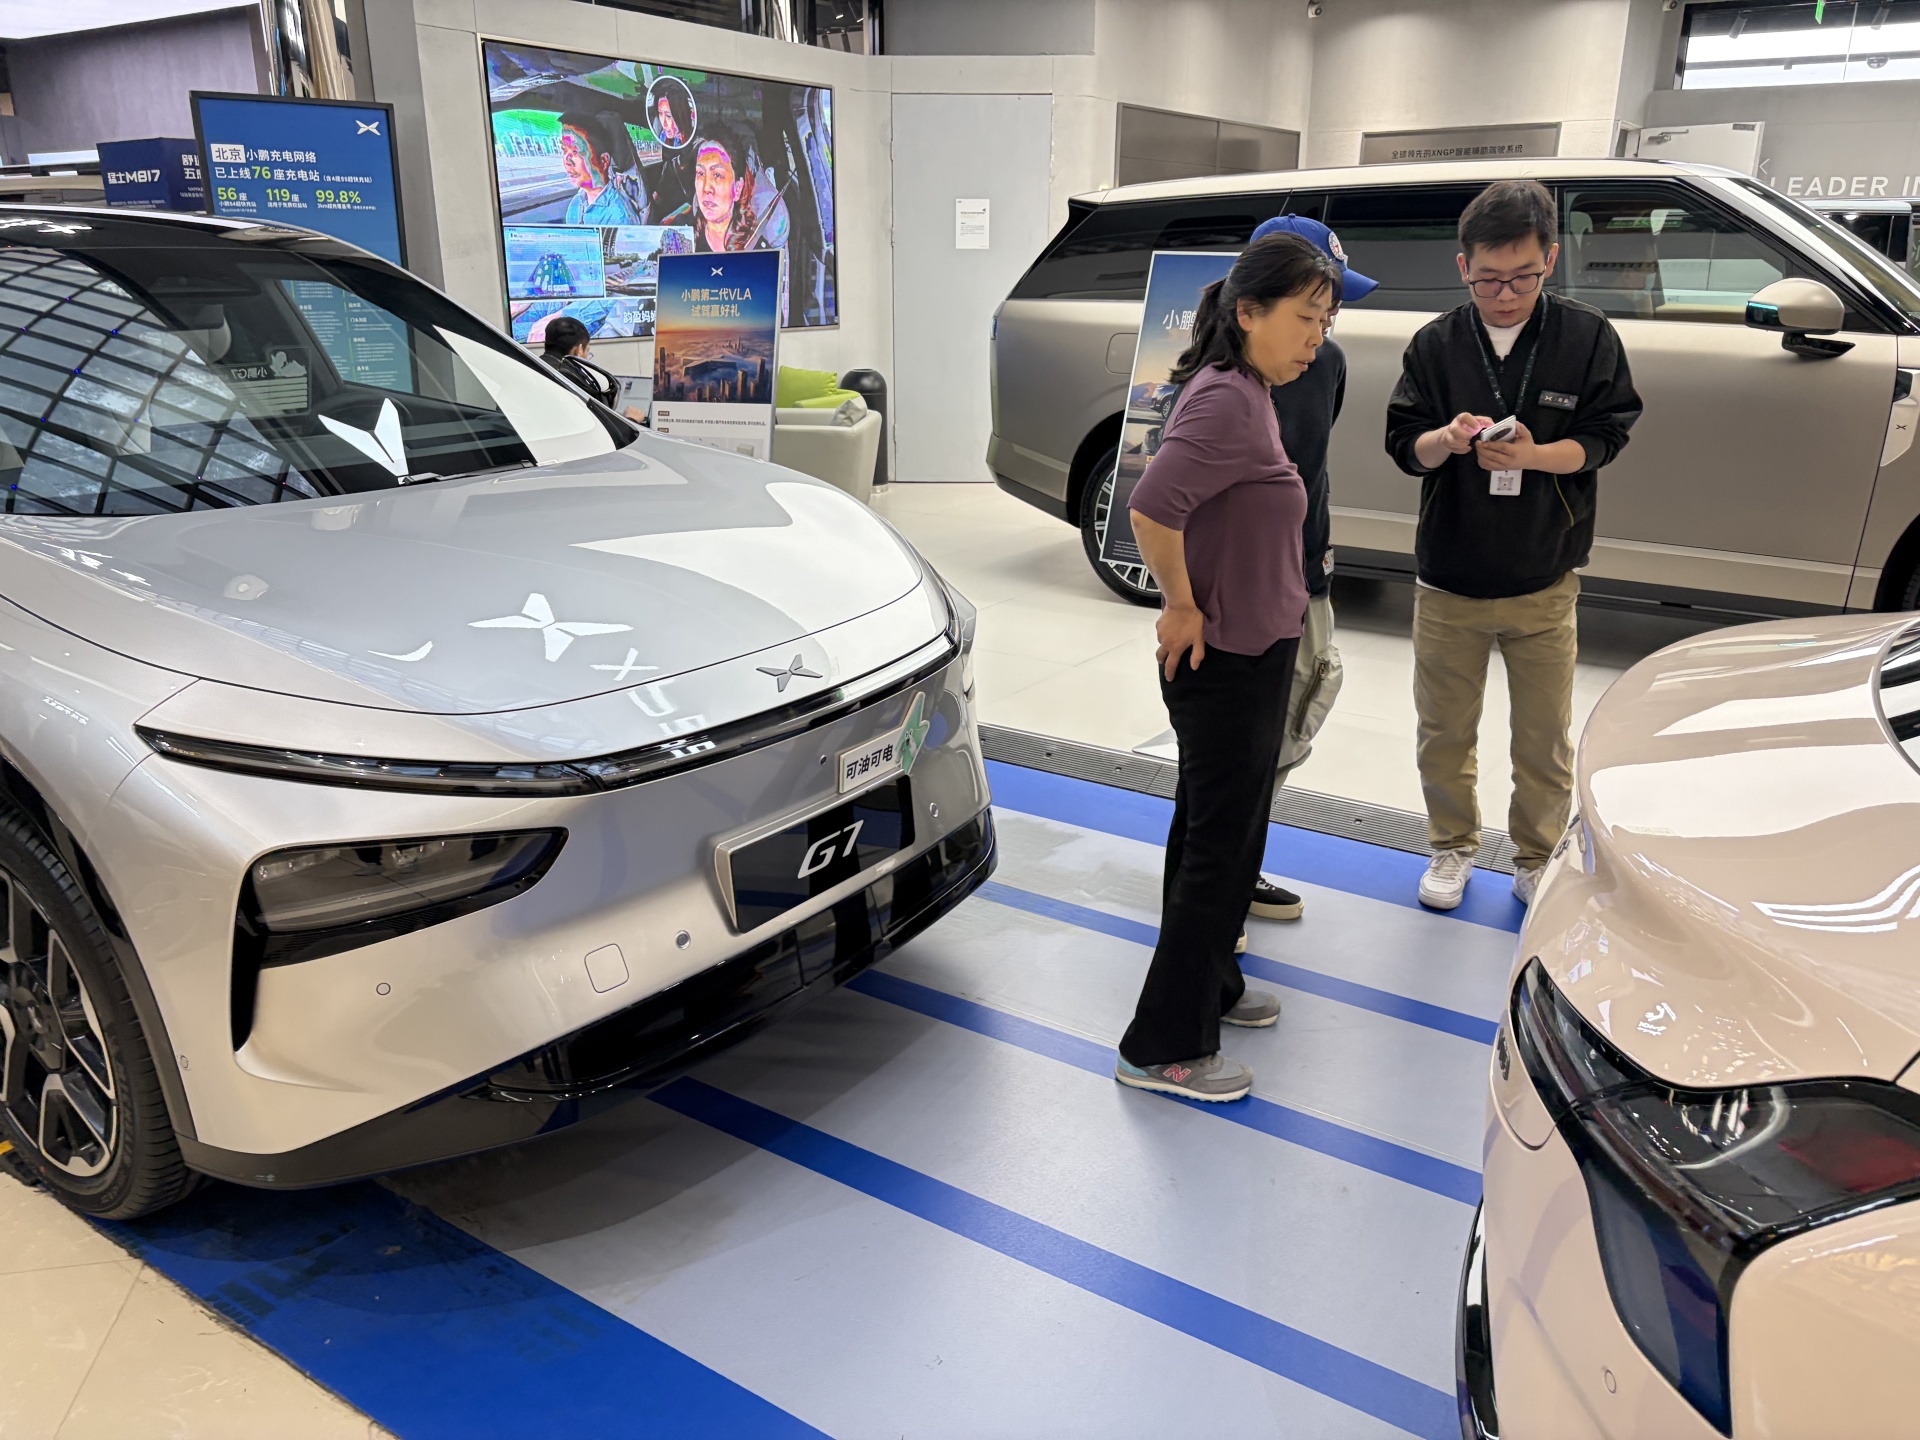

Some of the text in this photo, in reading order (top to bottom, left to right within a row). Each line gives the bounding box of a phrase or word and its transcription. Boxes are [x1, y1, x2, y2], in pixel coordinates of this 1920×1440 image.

[315, 189, 362, 204] 99.8%
[681, 287, 752, 302] 小鹏第二代VLA
[691, 303, 740, 318] 试驾赢好礼
[846, 744, 893, 780] 可油可电
[797, 819, 864, 879] G7
